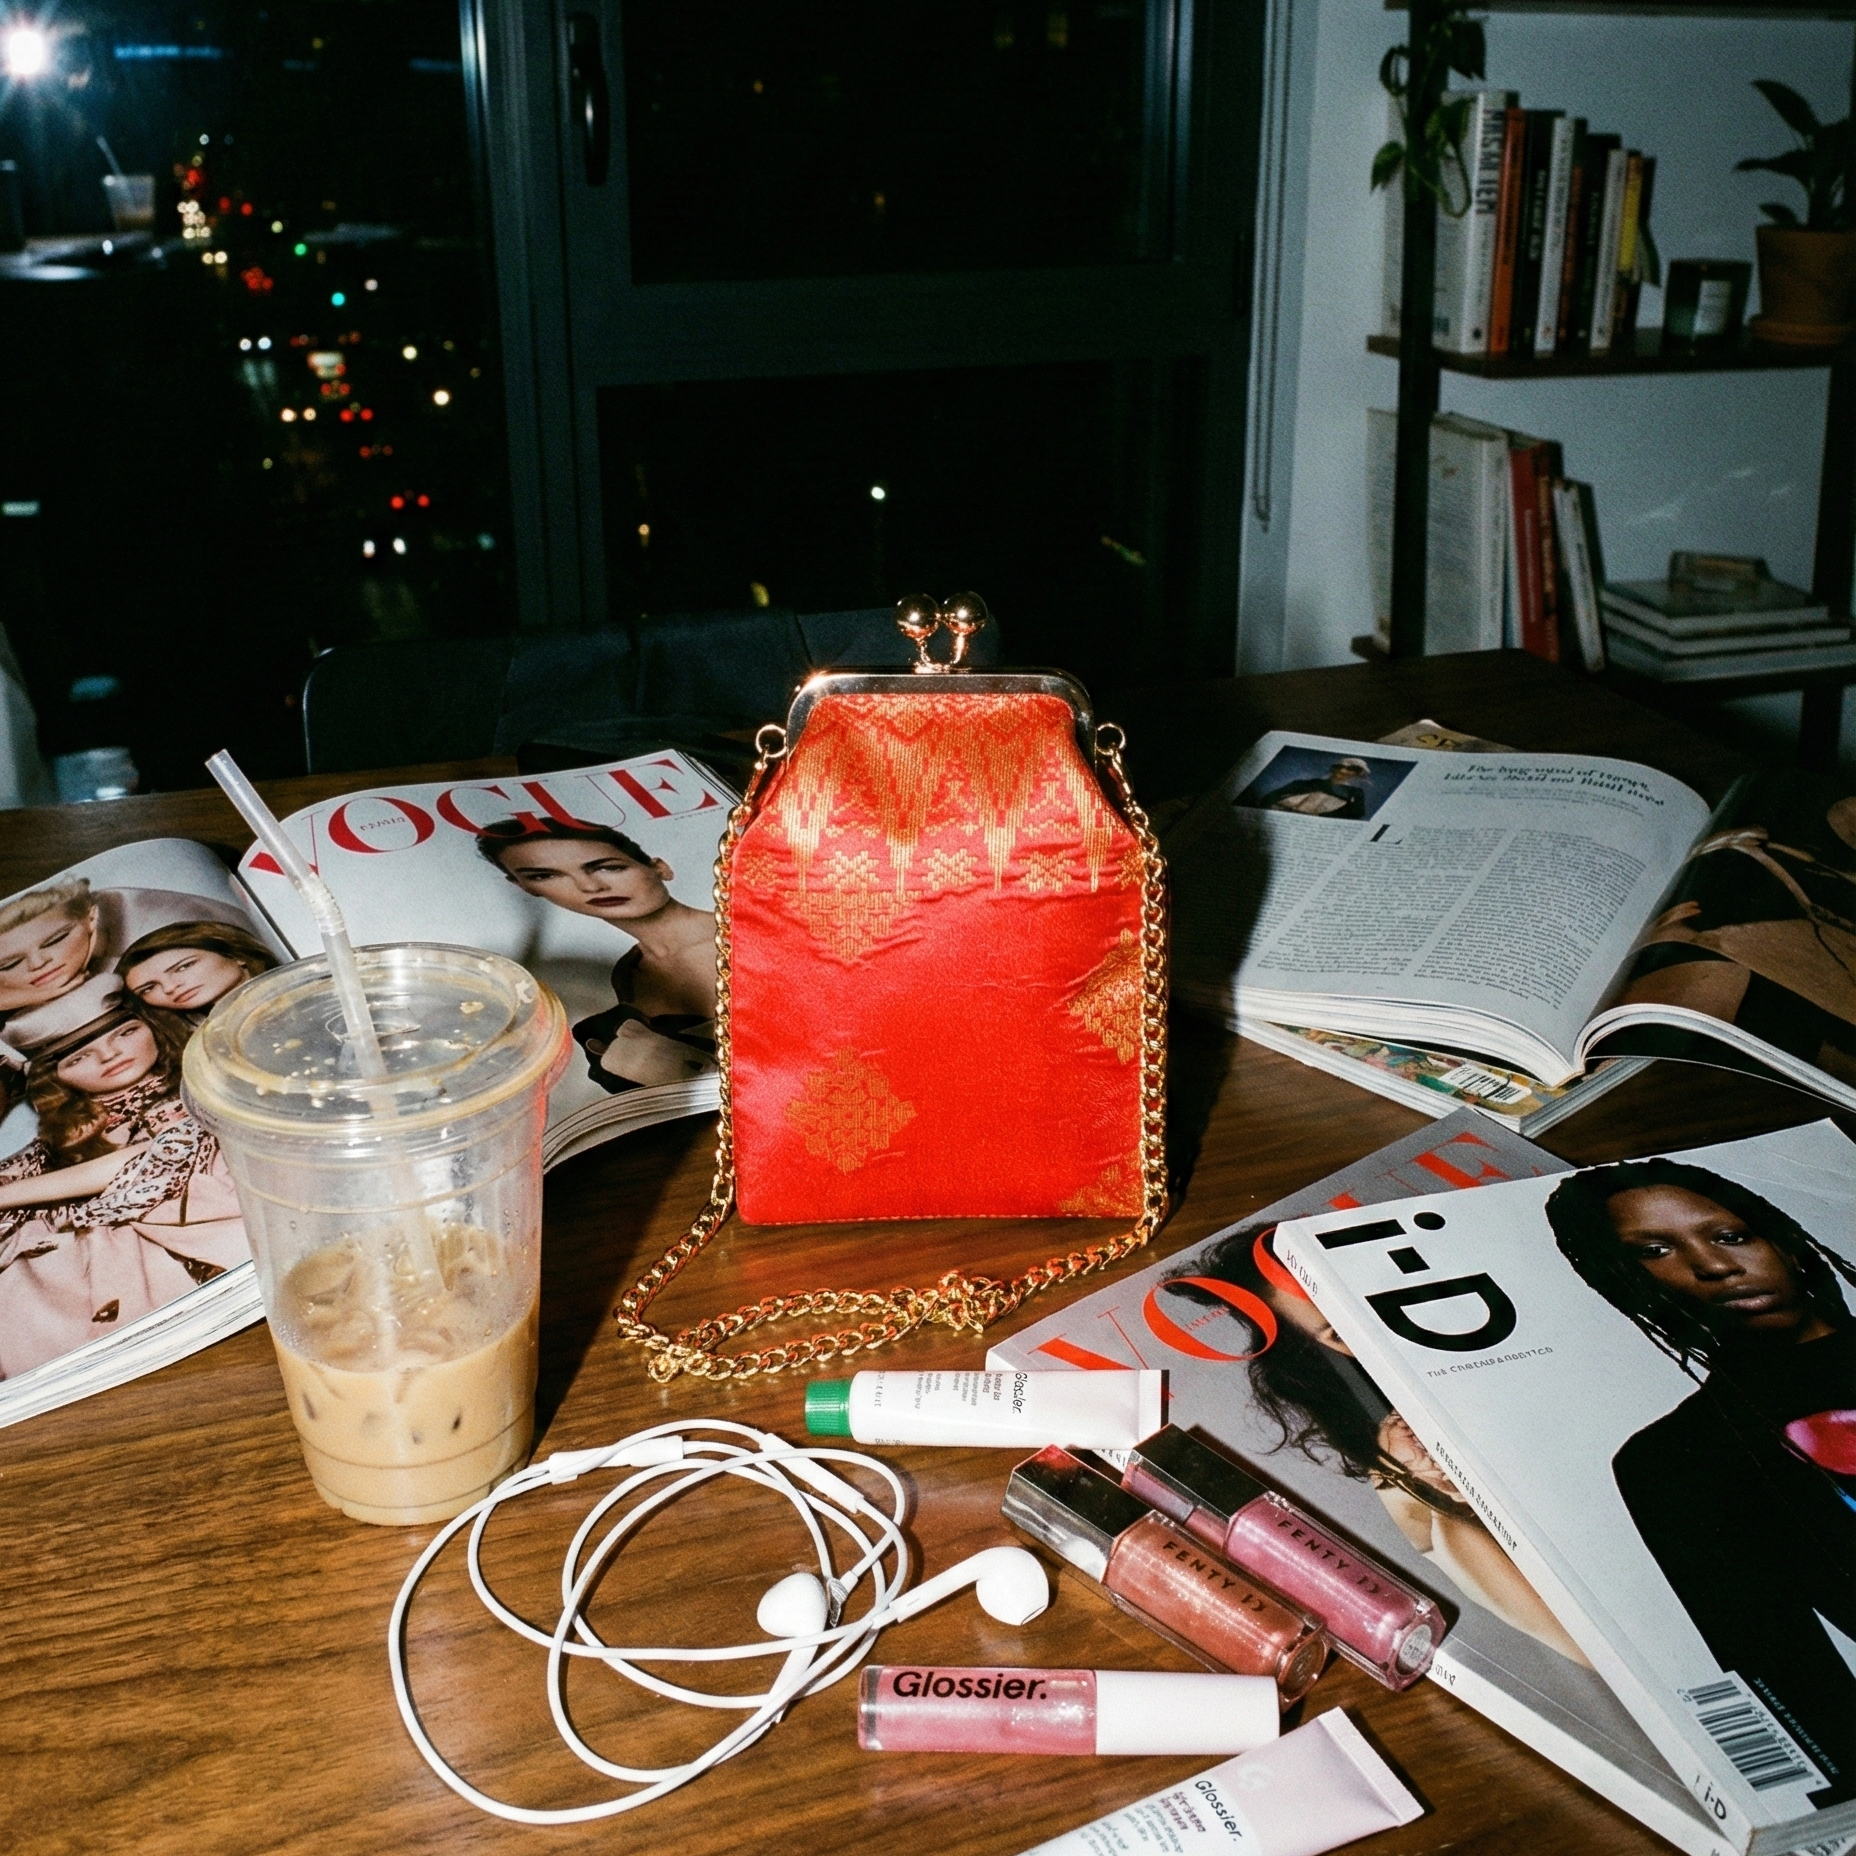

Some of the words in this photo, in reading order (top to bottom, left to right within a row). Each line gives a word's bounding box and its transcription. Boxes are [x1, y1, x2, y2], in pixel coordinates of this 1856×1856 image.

[1028, 1130, 1546, 1398] VOE
[1163, 1541, 1235, 1590] FENTY
[1278, 1520, 1350, 1570] FENTY
[893, 1671, 1047, 1701] Glossier.
[1194, 1780, 1242, 1842] Glossier.
